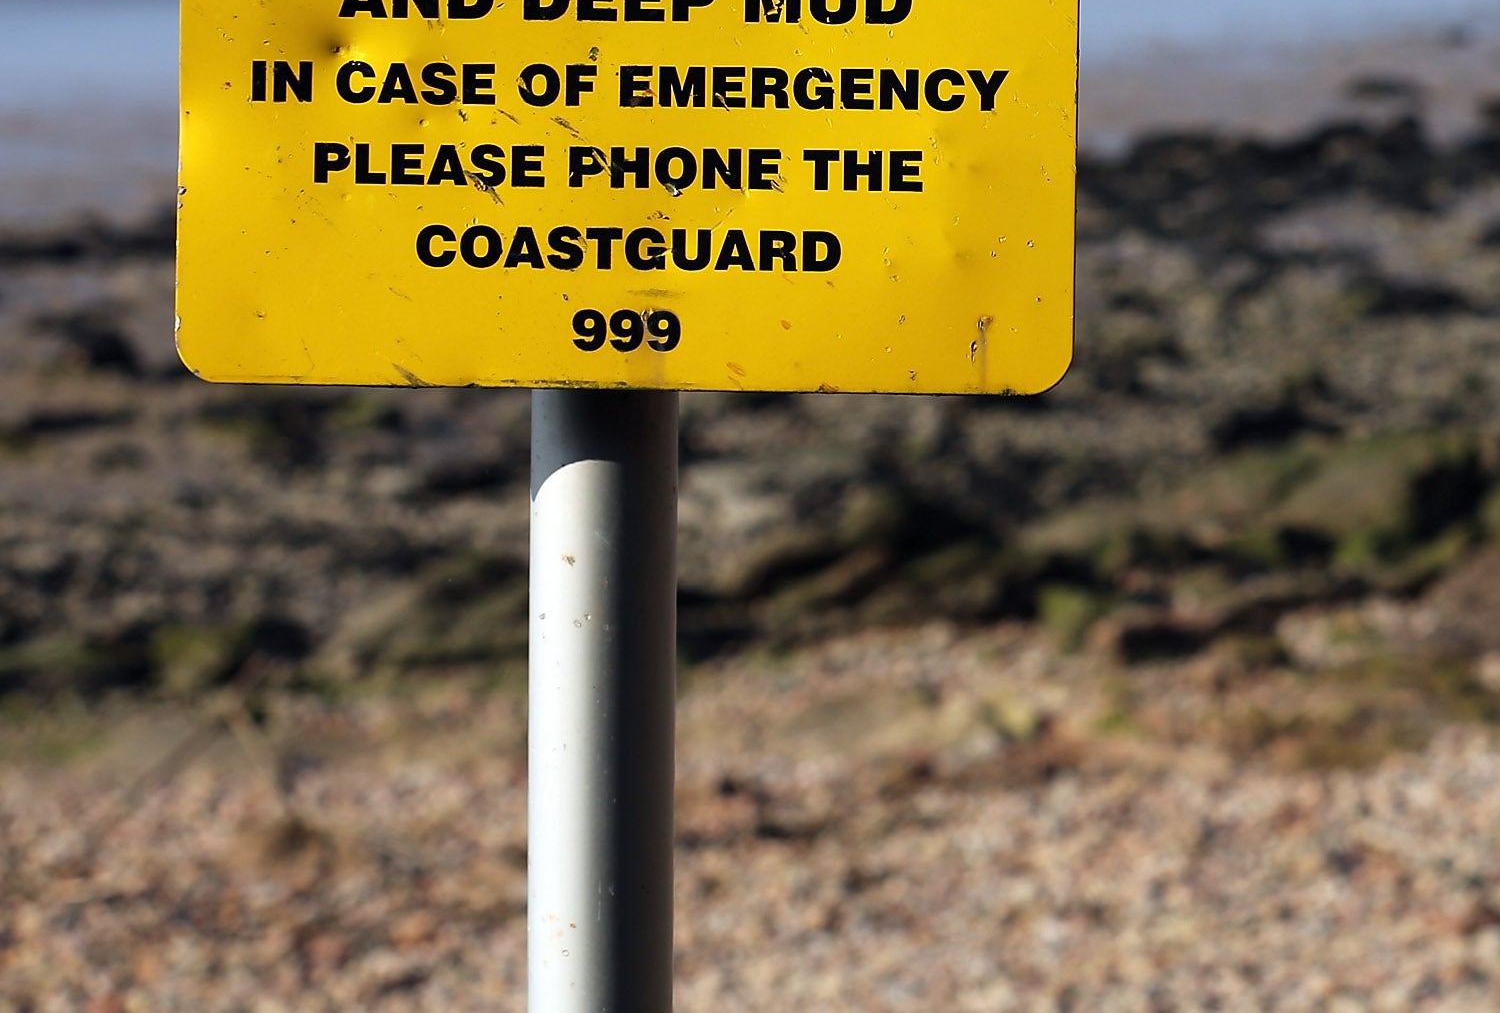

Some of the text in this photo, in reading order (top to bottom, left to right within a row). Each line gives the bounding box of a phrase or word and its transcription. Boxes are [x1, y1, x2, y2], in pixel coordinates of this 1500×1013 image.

[251, 60, 1009, 112] IN CASE OF EMERGENCY
[314, 142, 923, 193] PLEASE PHONE THE
[416, 224, 841, 272] COASTGUARD
[572, 309, 681, 353] 999
